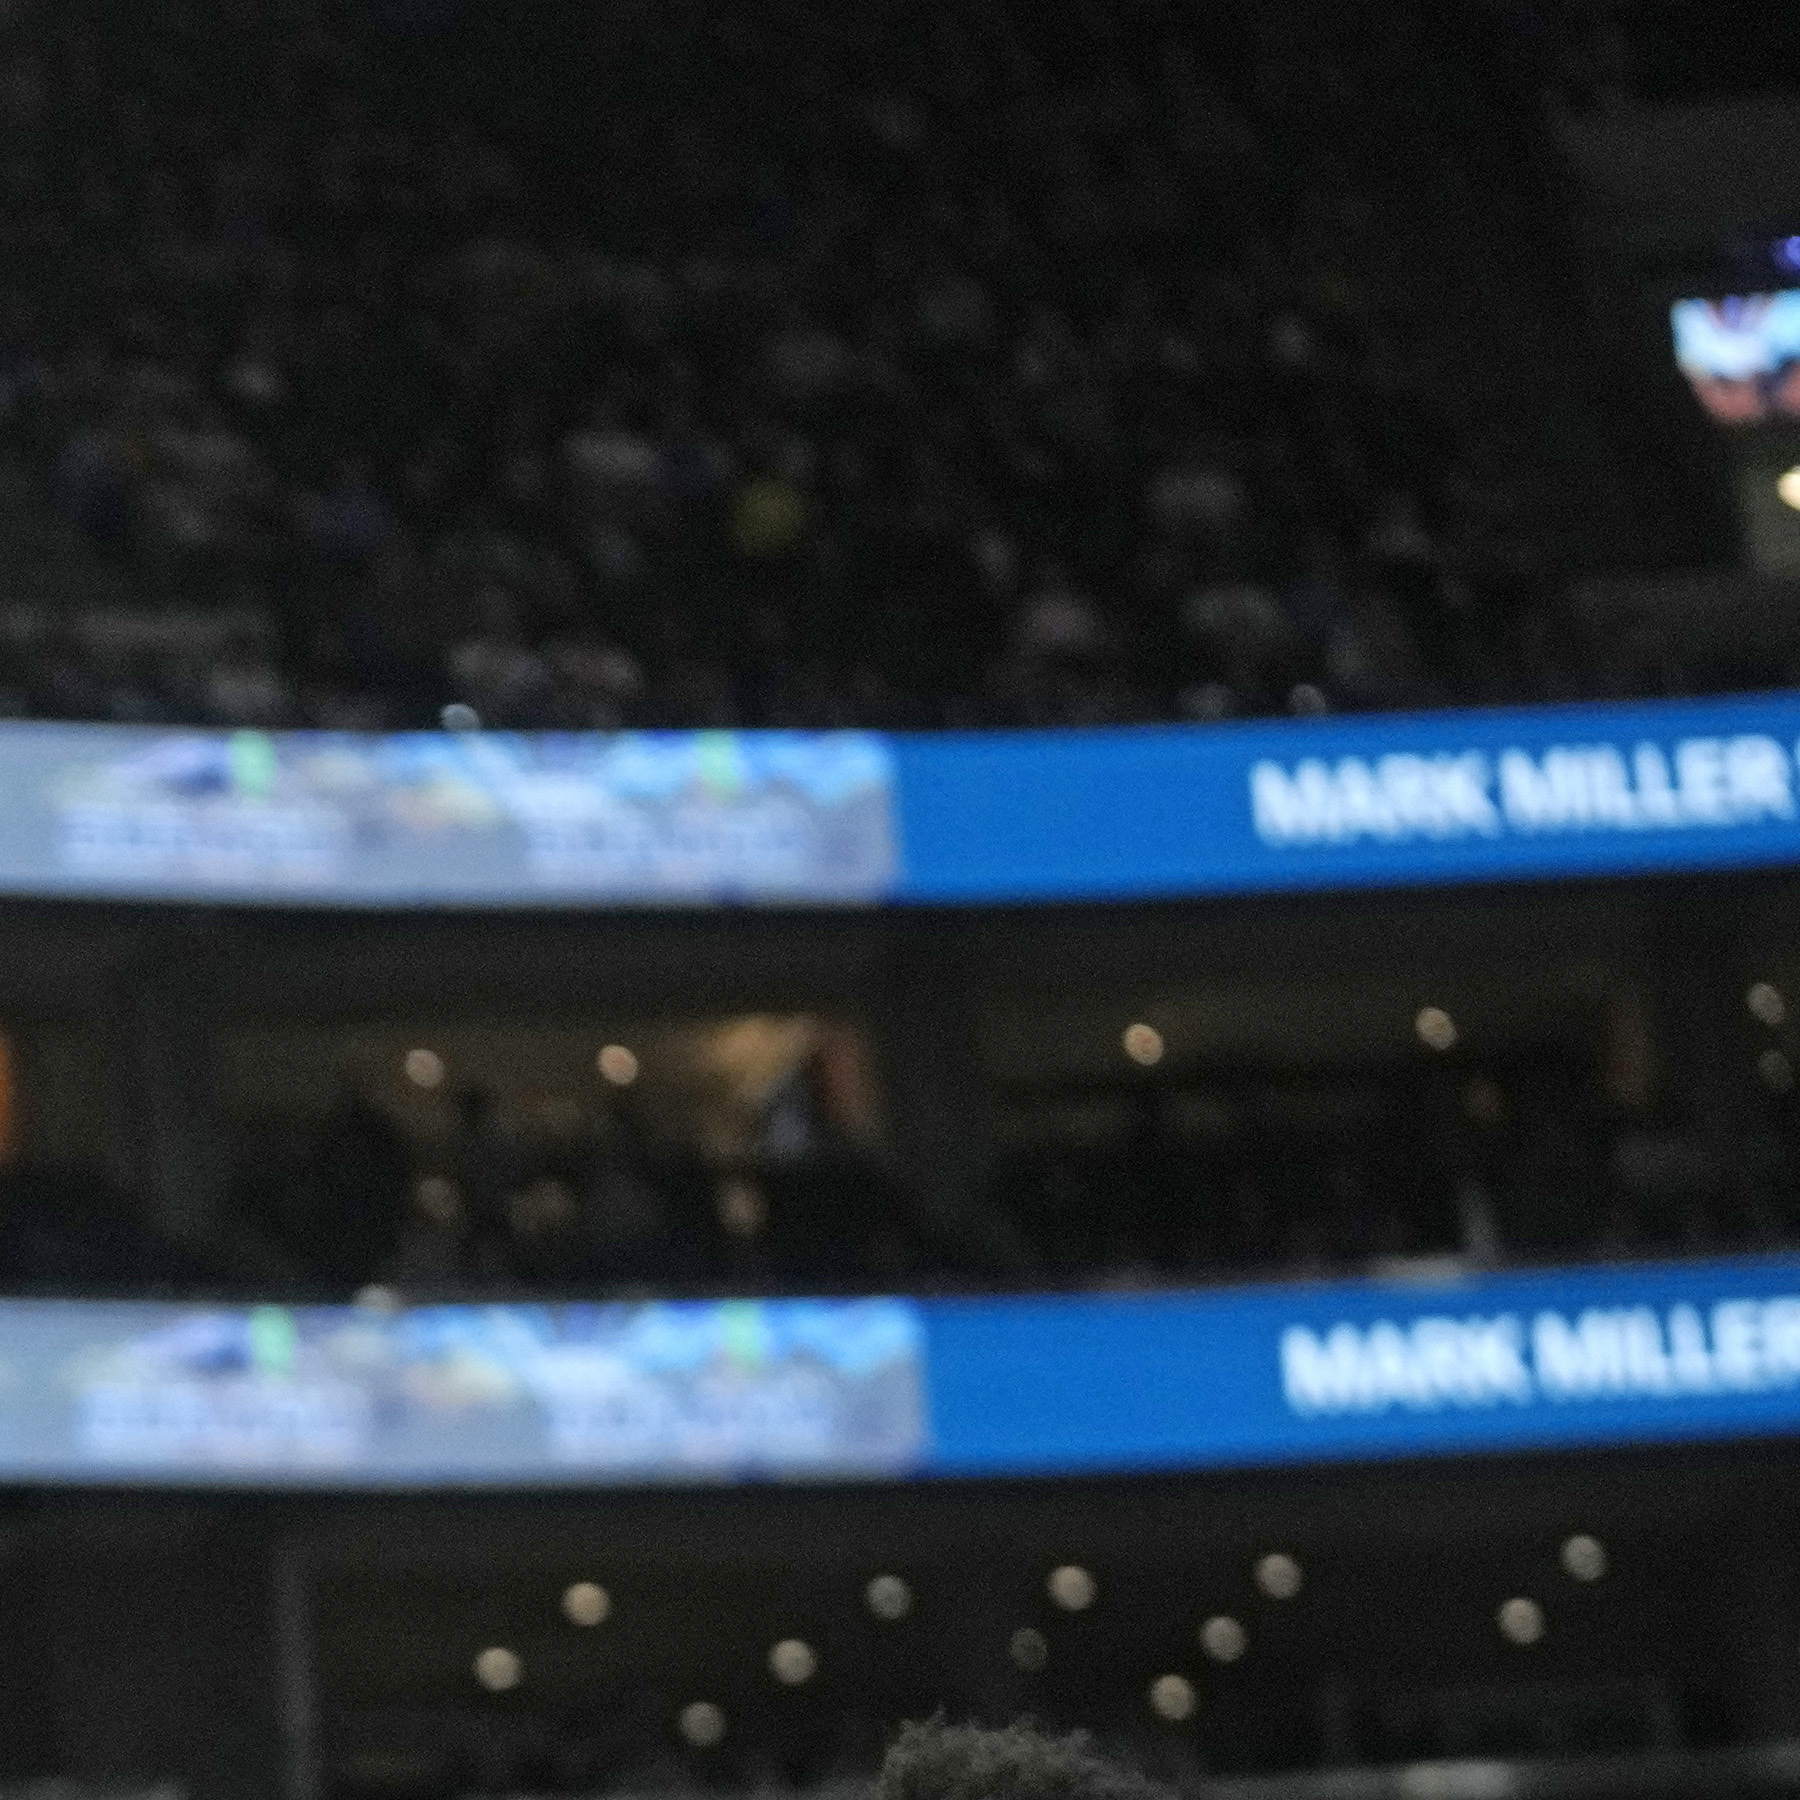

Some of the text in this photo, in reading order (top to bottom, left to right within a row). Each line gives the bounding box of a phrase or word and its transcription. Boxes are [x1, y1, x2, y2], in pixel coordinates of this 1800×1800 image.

[1250, 735, 1794, 846] MARK MILLER
[1280, 1312, 1530, 1414] MARK
